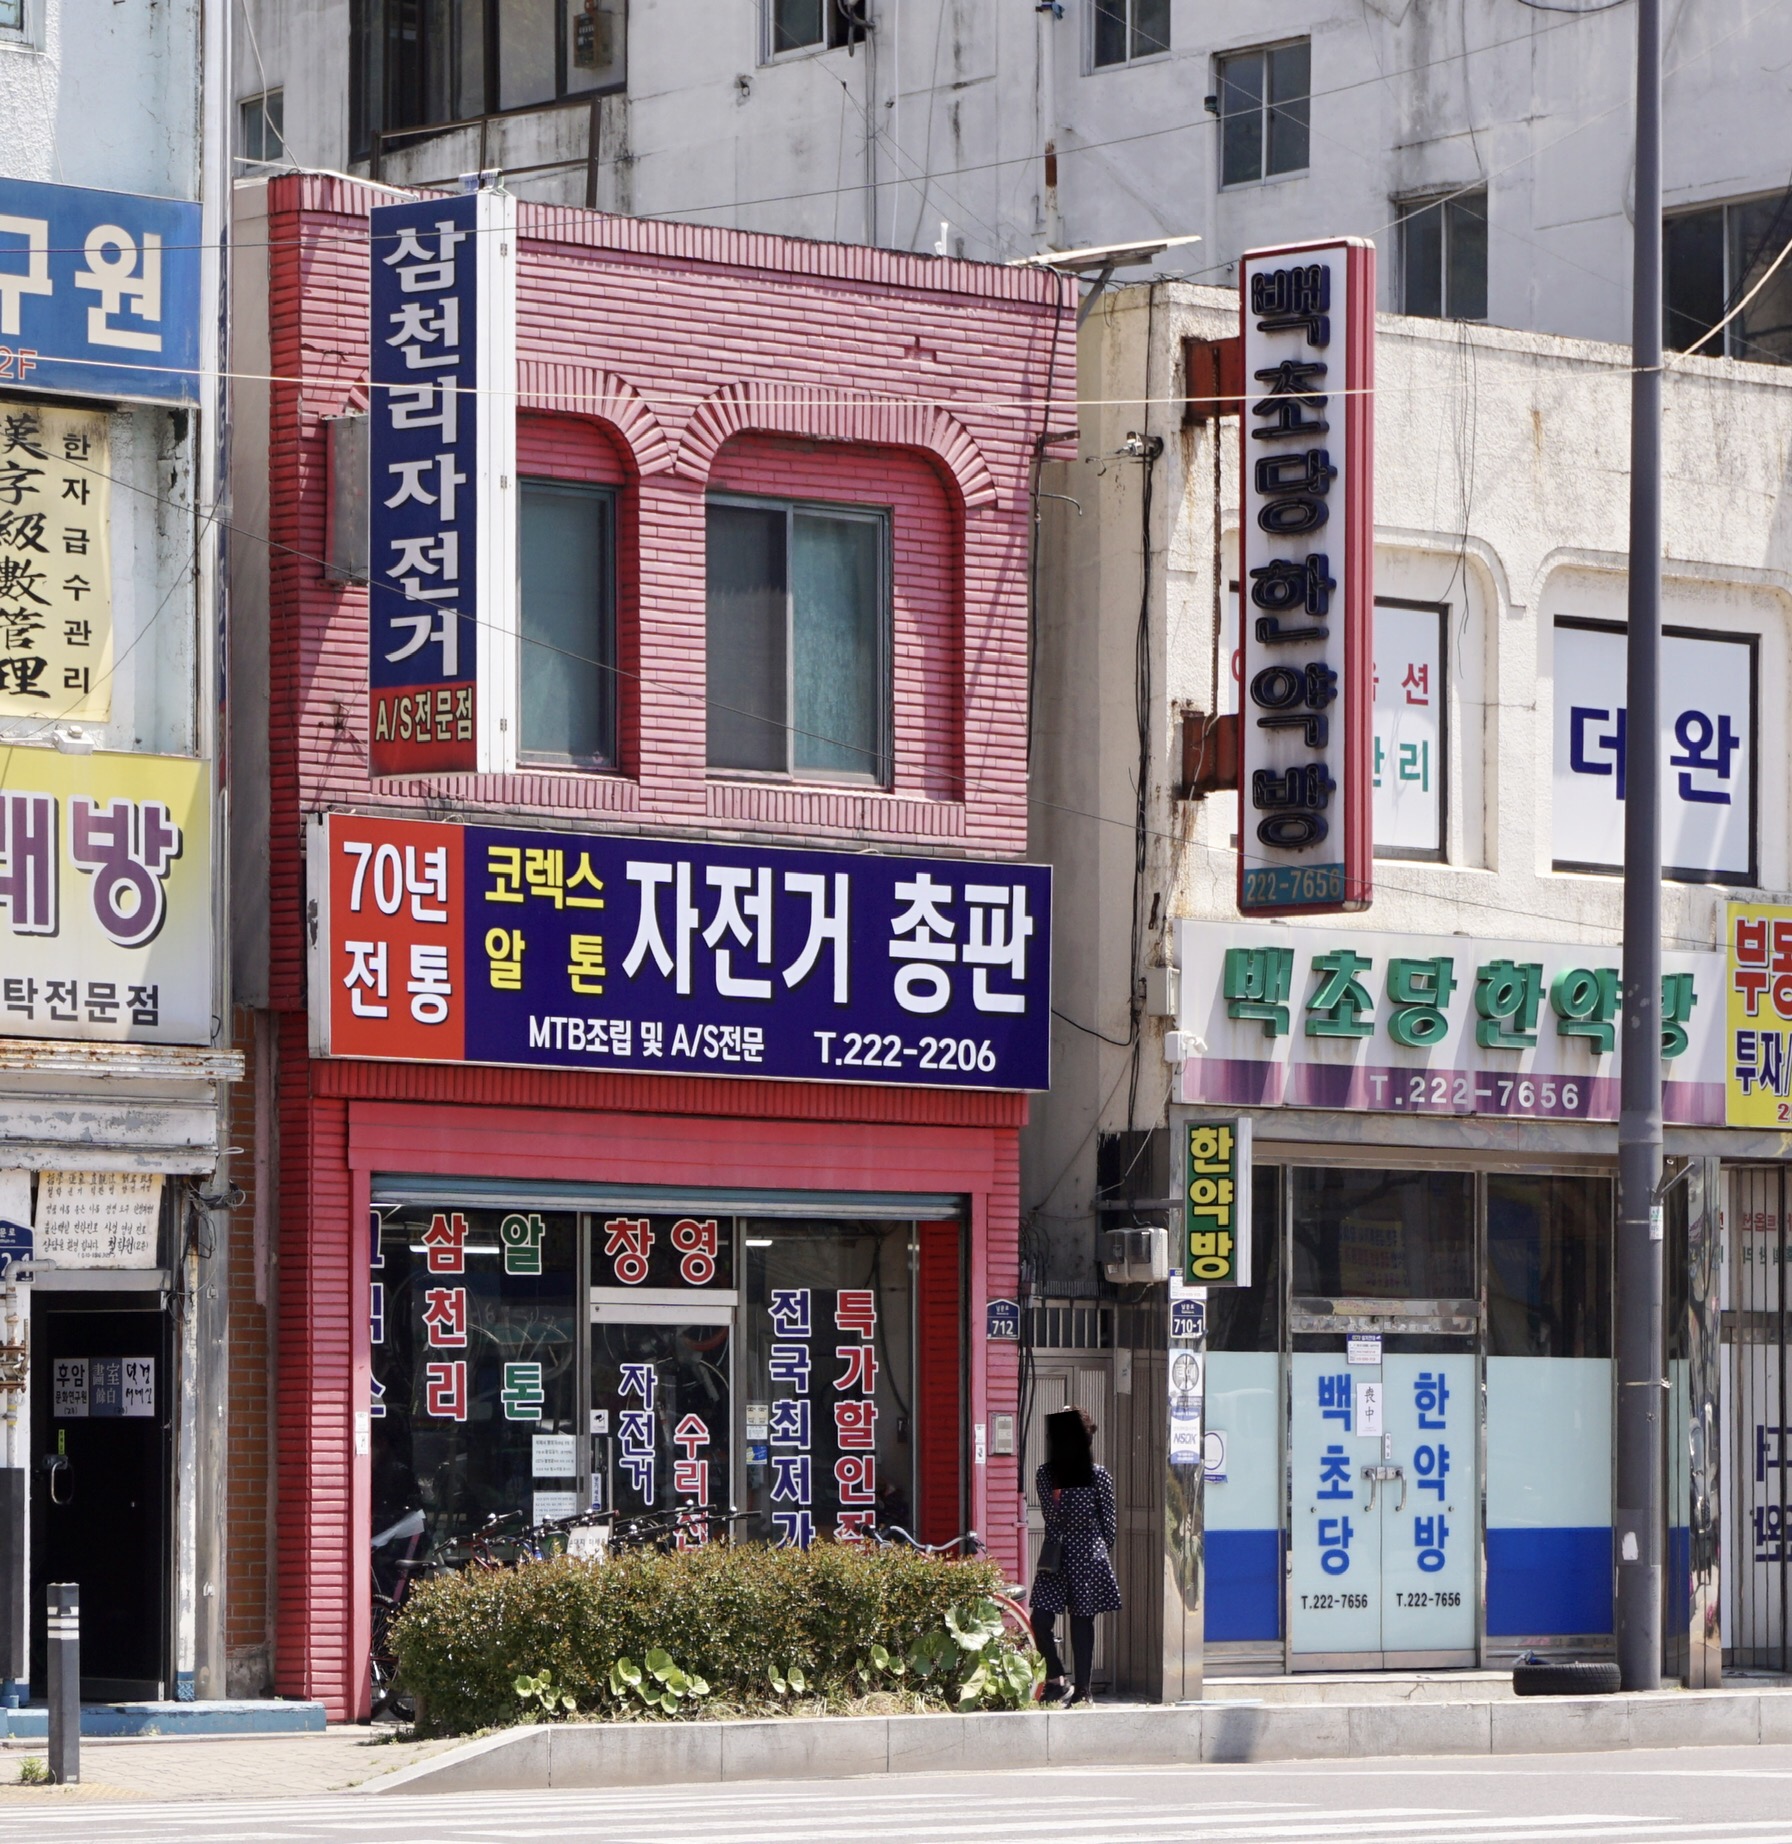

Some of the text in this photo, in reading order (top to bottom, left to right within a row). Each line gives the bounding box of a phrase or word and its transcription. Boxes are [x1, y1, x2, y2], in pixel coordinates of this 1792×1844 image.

[382, 219, 466, 677] 삼천리자전거
[61, 432, 92, 694] 한자급수관리
[1250, 264, 1338, 848] 백초당한약방
[375, 687, 472, 742] A/S전문점
[343, 840, 448, 923] 70년
[485, 845, 604, 909] 코렉스
[1247, 868, 1341, 901] 222-7656
[622, 860, 1033, 1014] 자전거 총판
[3, 977, 159, 1027] 탁전문점
[529, 1015, 764, 1062] MTB조립 및 A/S전문
[814, 1031, 996, 1072] T.222-2206
[1370, 1074, 1579, 1110] T.222-7656
[1189, 1126, 1233, 1279] 한약방
[604, 1217, 718, 1284] 창영
[422, 1212, 468, 1422] 삼천리
[992, 1320, 1014, 1335] 712
[1174, 1318, 1203, 1333] 710-1
[56, 1363, 85, 1388] 후암
[618, 1362, 657, 1505] 자전거
[768, 1288, 816, 1550] 전국최저가
[1316, 1373, 1354, 1576] 백초당
[1413, 1372, 1449, 1573] 한약방
[1301, 1594, 1368, 1609] T.222-7656
[1396, 1592, 1461, 1608] T.222-7656
